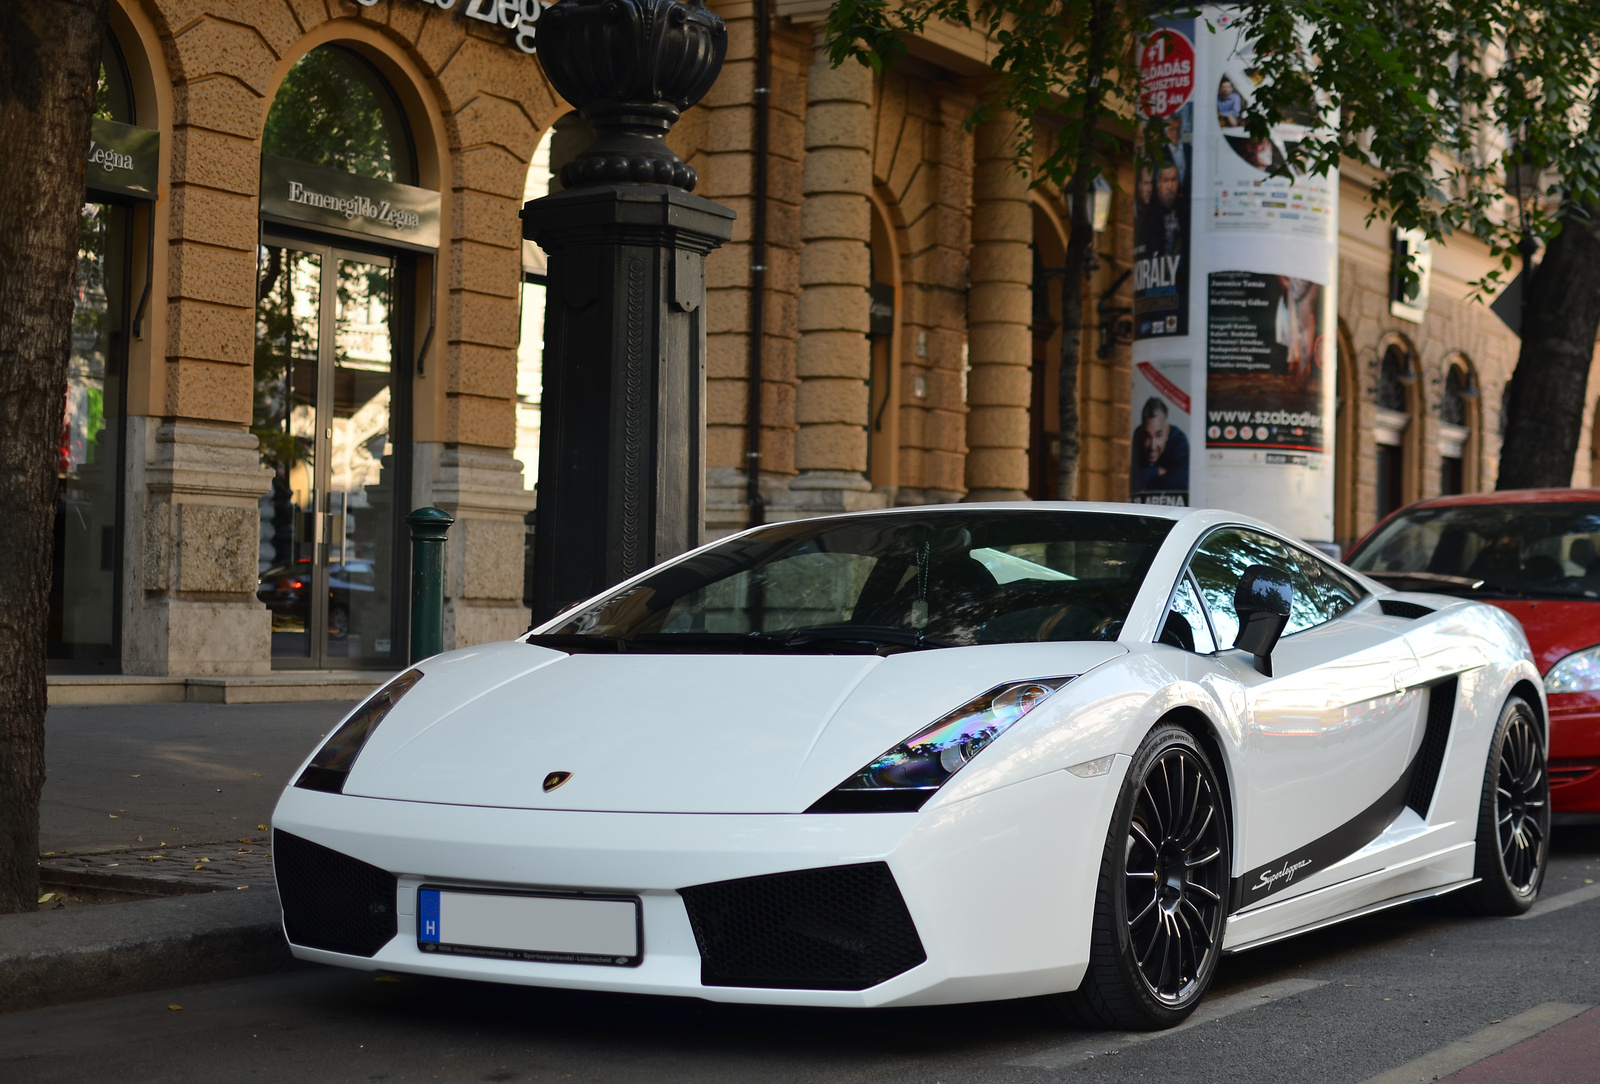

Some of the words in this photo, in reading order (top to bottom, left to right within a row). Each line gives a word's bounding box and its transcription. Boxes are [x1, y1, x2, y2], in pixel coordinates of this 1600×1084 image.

[288, 180, 378, 219] Ermenegildo
[379, 200, 419, 231] Zegna
[1133, 251, 1181, 291] KIRÁLY
[426, 920, 436, 936] H
